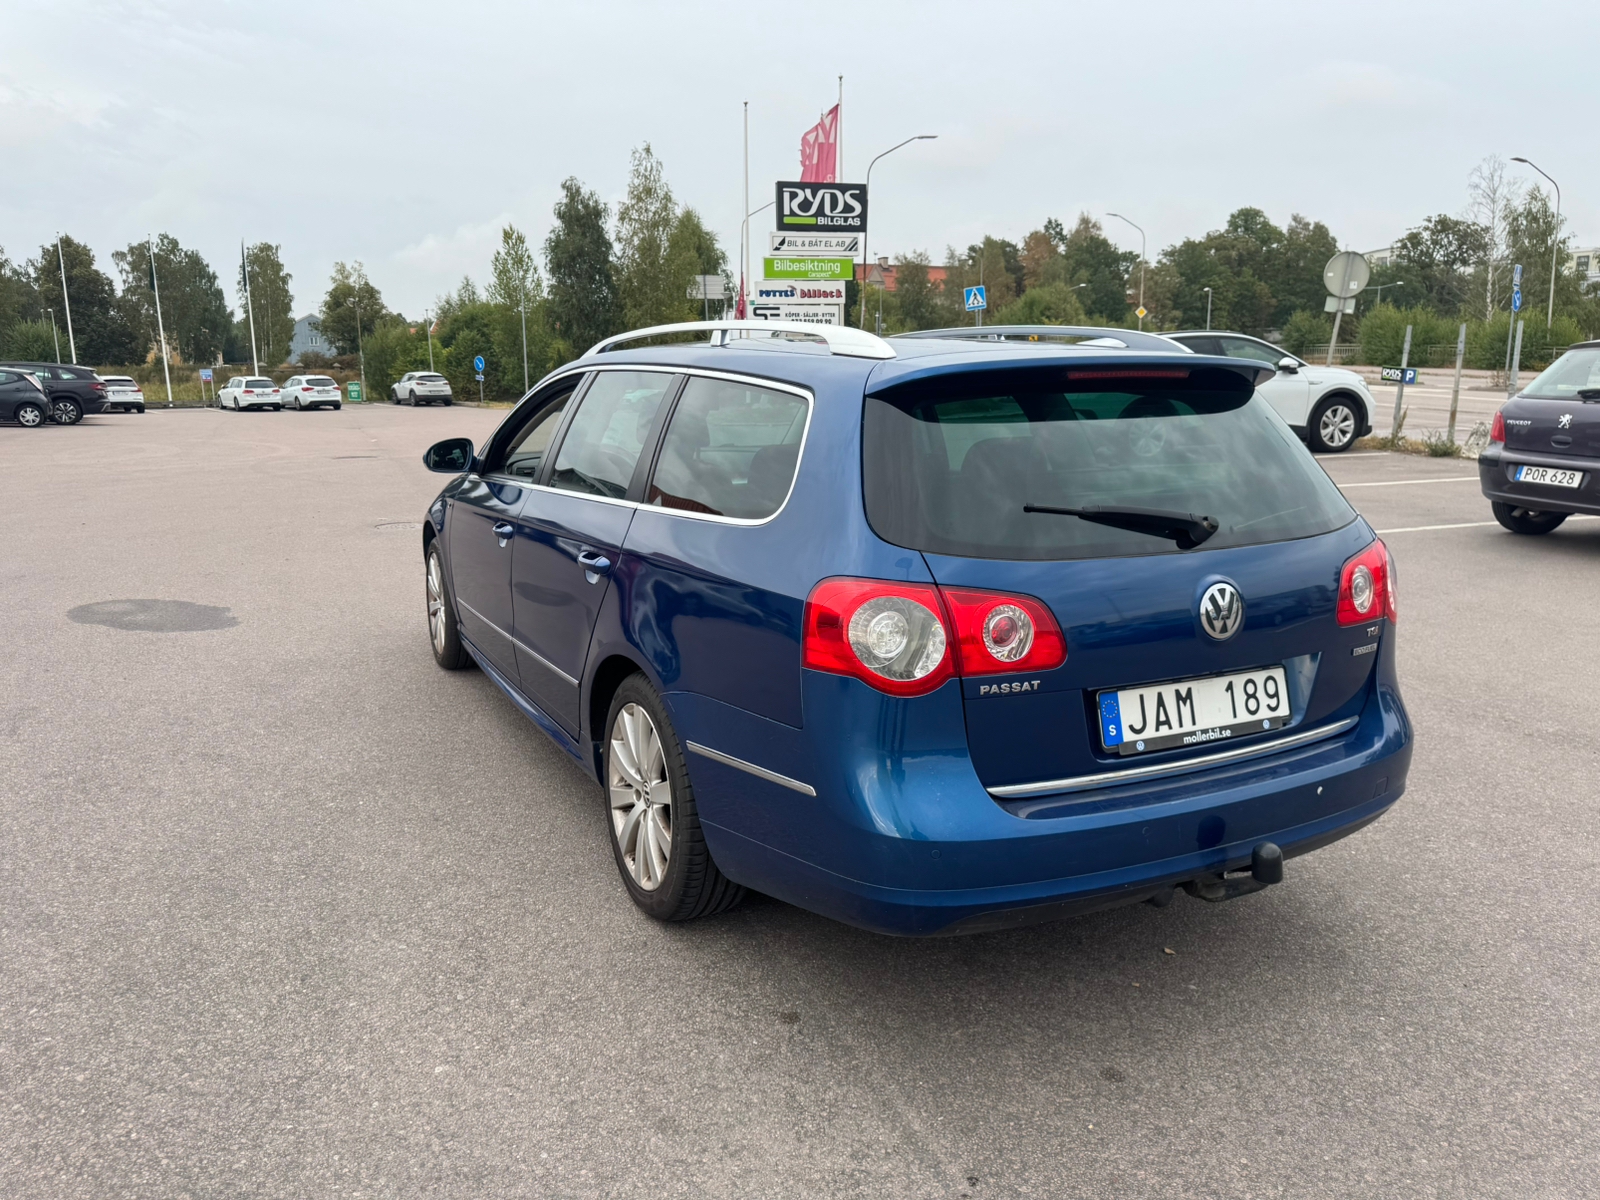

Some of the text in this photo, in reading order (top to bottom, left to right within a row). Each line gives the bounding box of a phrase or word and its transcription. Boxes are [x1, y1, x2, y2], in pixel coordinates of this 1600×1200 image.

[783, 187, 862, 217] RYDS
[817, 217, 861, 226] BILGLAS
[835, 240, 846, 248] AB
[774, 260, 840, 273] Bilbesiktning
[1405, 370, 1414, 381] P
[1524, 467, 1576, 485] POR 628
[980, 680, 1040, 696] PASSAT
[1109, 675, 1280, 736] S JAM 189
[1183, 728, 1231, 744] mollerbil.se
